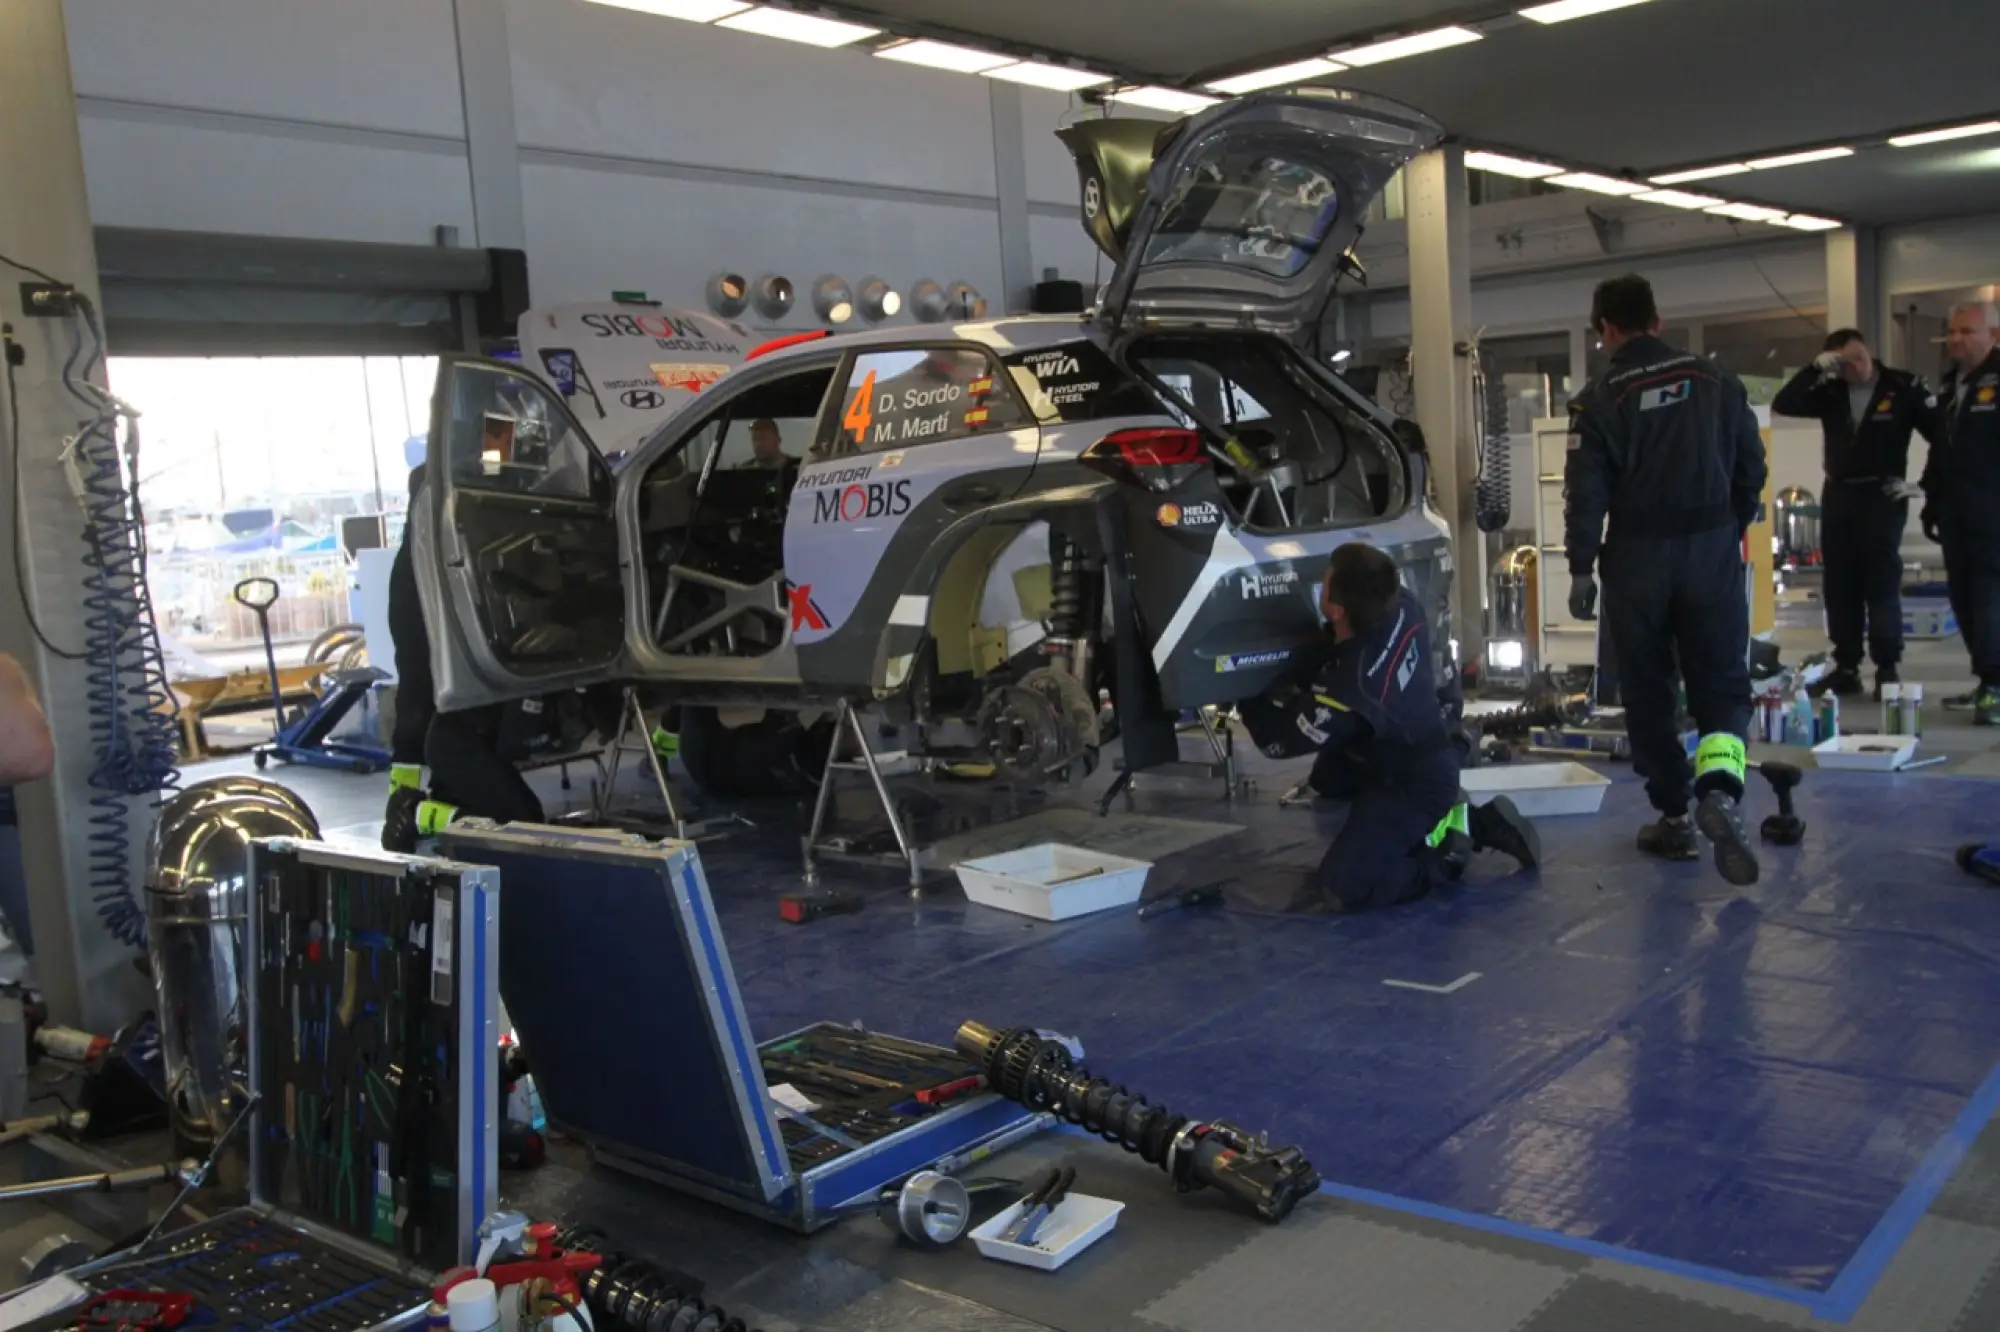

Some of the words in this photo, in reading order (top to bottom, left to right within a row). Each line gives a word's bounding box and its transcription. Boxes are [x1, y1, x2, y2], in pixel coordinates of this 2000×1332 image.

[580, 314, 704, 338] MOBIS
[843, 368, 876, 443] 4
[878, 394, 896, 414] D.
[902, 383, 961, 410] Sordo
[874, 423, 895, 444] M.
[901, 411, 951, 438] Martí
[799, 466, 873, 489] HYUNDAI
[813, 479, 912, 524] MOBIS
[1183, 501, 1219, 516] HELIX
[1183, 512, 1217, 526] ULTRA
